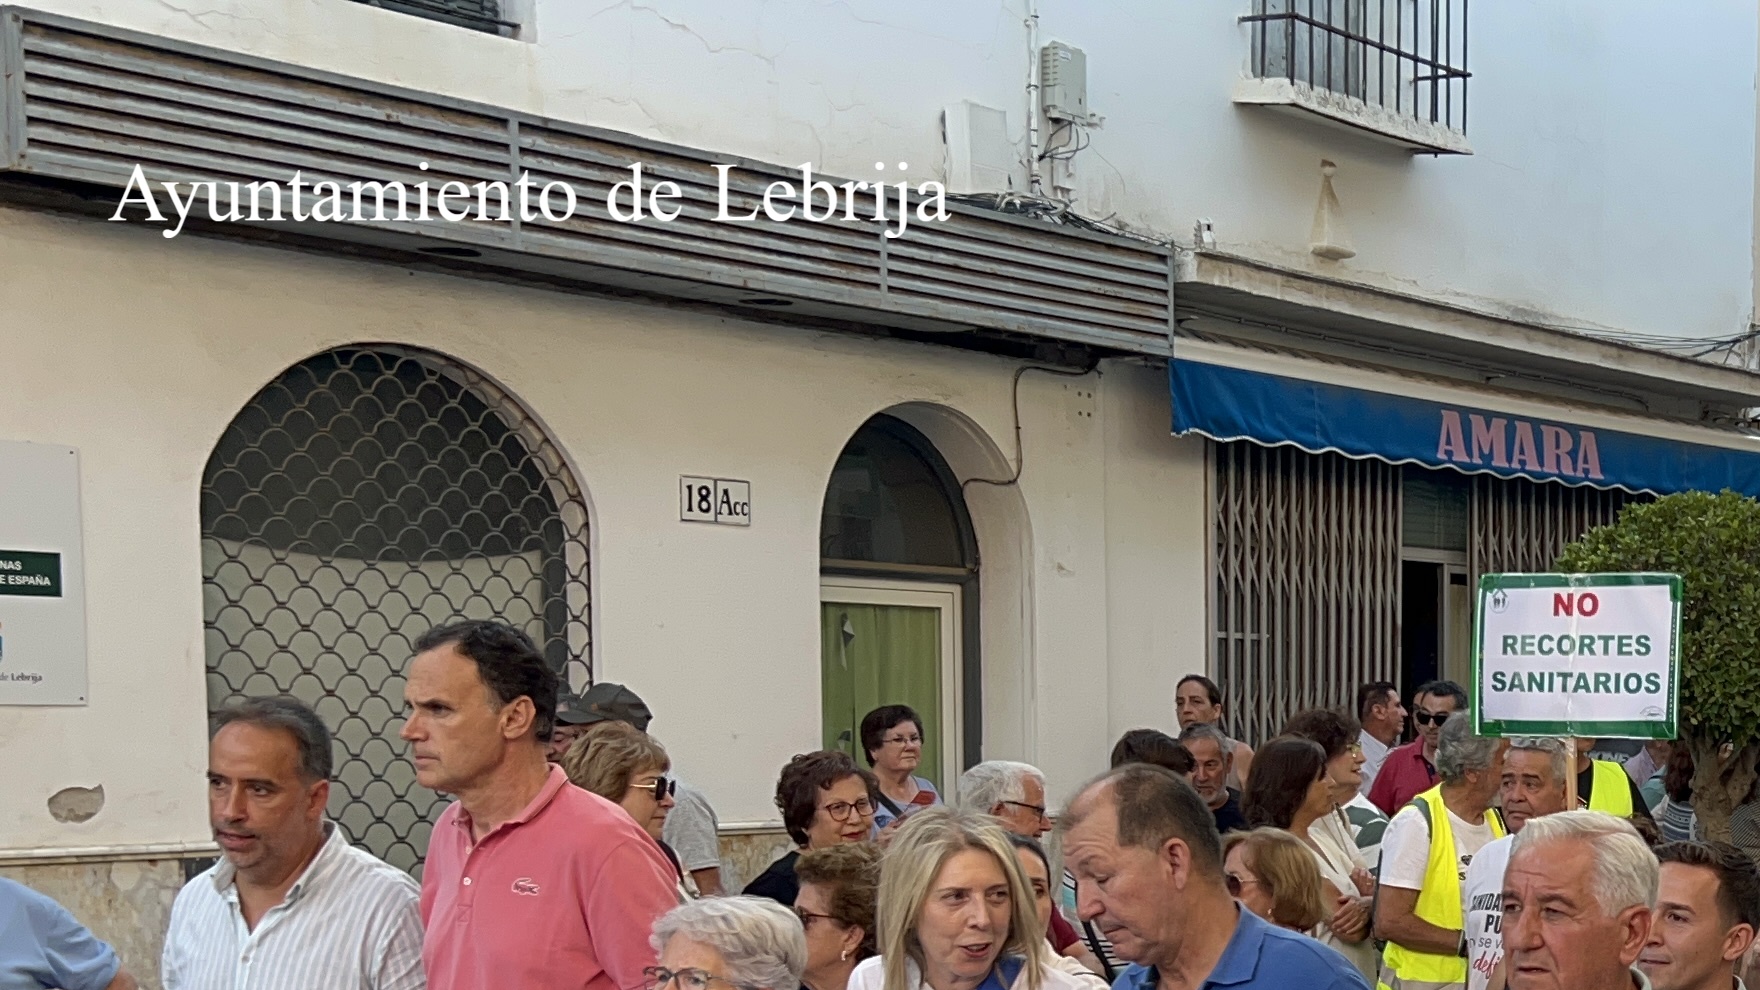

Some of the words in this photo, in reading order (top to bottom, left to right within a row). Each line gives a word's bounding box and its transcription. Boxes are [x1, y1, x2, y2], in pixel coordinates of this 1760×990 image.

[1437, 409, 1604, 480] AMARA
[686, 484, 711, 513] 18
[717, 488, 748, 516] Acc
[8, 574, 51, 586] ESPAÑA
[1552, 592, 1599, 618] NO
[1501, 634, 1652, 657] RECORTES
[1491, 670, 1662, 695] SANITARIOS
[1470, 893, 1502, 912] SANIDA
